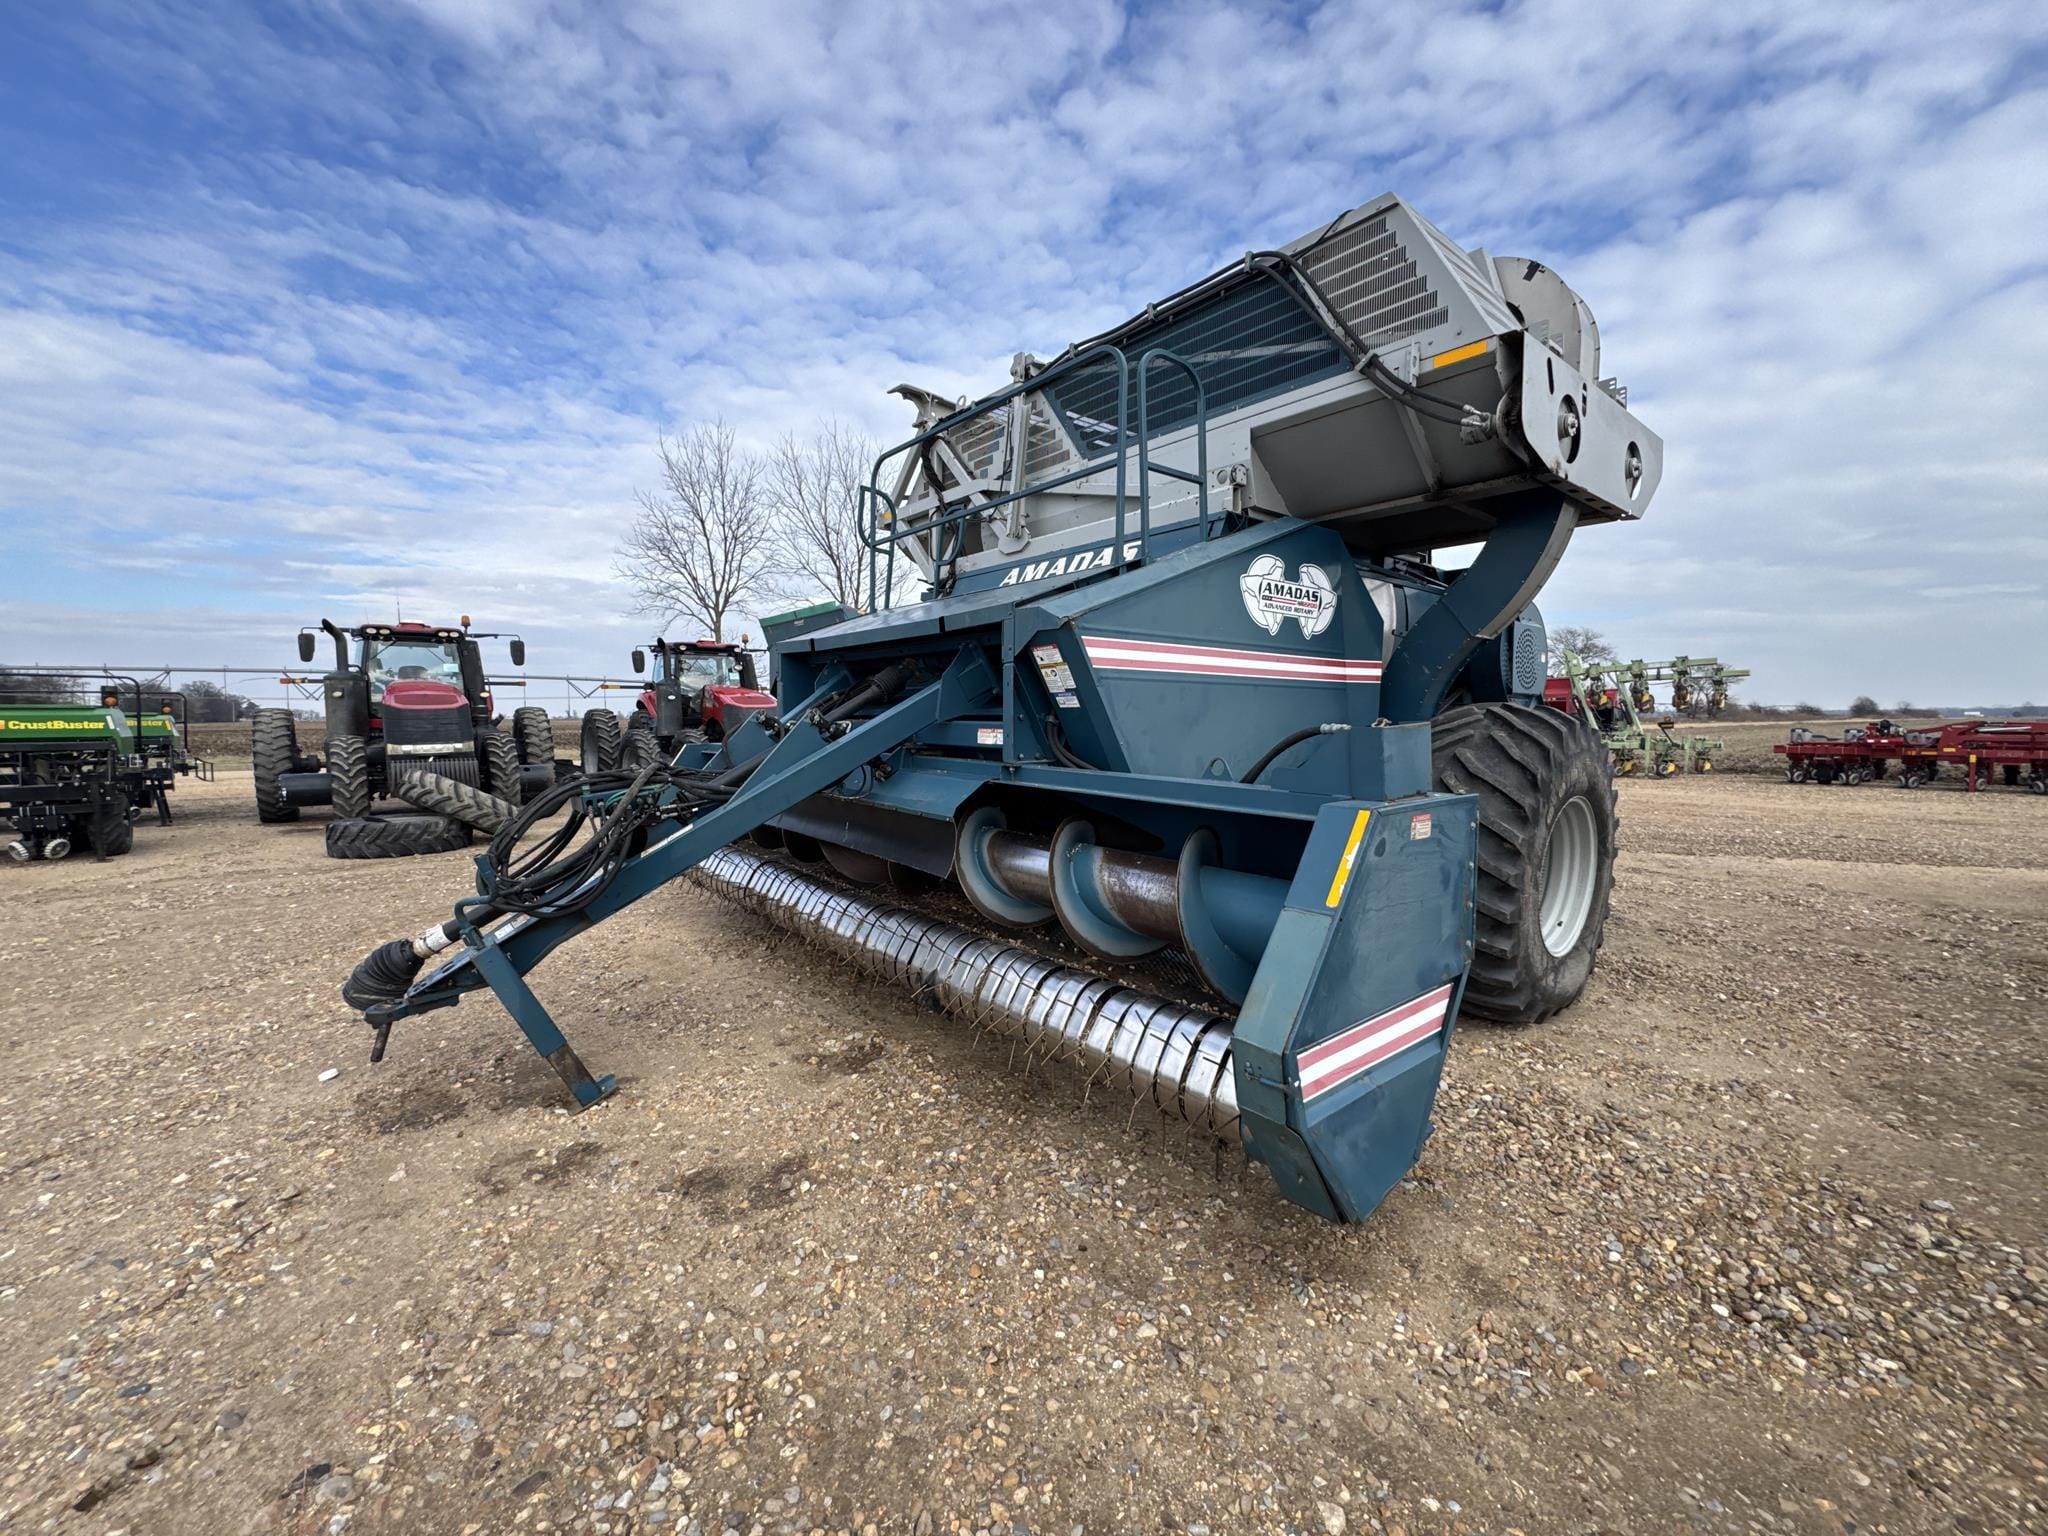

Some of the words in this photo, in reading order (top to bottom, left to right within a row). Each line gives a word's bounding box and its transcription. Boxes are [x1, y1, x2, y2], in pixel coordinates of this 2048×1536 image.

[999, 540, 1142, 587] AMADAS
[1263, 582, 1319, 602] AMADAS
[1264, 602, 1292, 612] ADVANCED
[8, 720, 104, 730] CrustBuster
